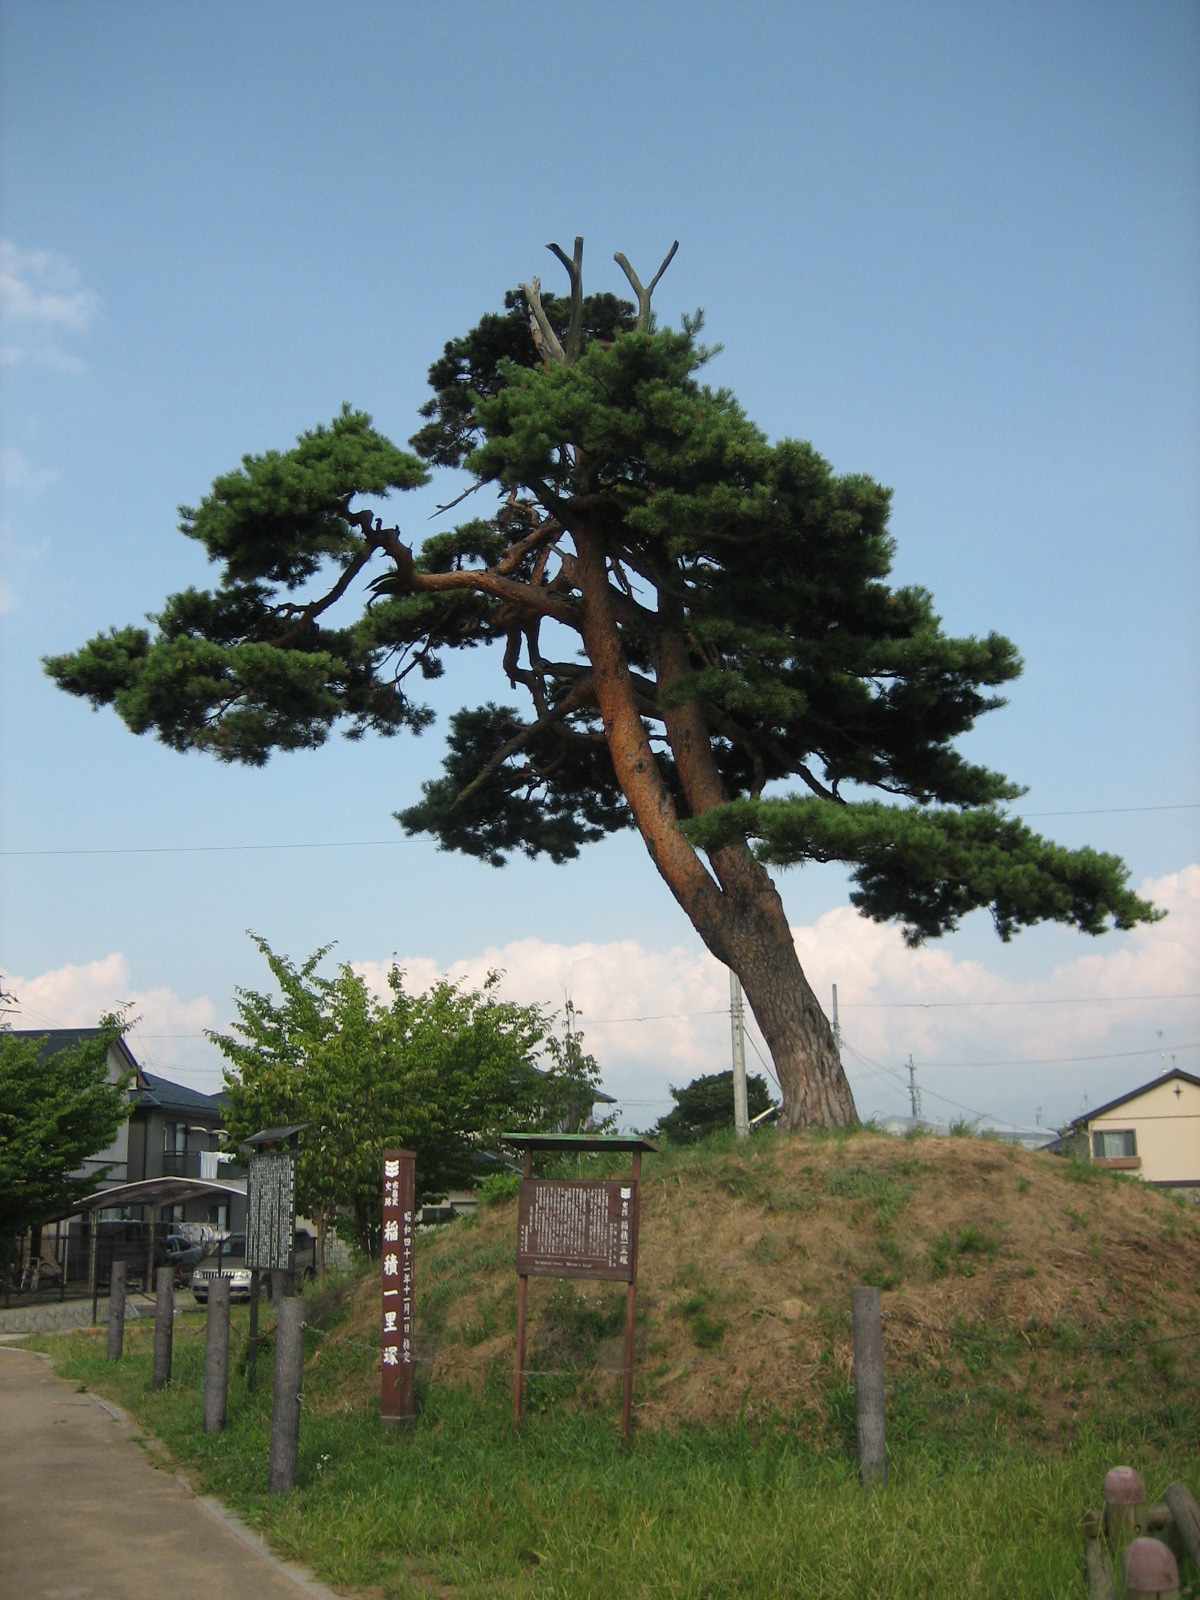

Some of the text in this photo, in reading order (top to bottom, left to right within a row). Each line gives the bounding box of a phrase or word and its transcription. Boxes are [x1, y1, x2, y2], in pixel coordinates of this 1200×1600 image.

[384, 1221, 398, 1365] 稲積一里塚
